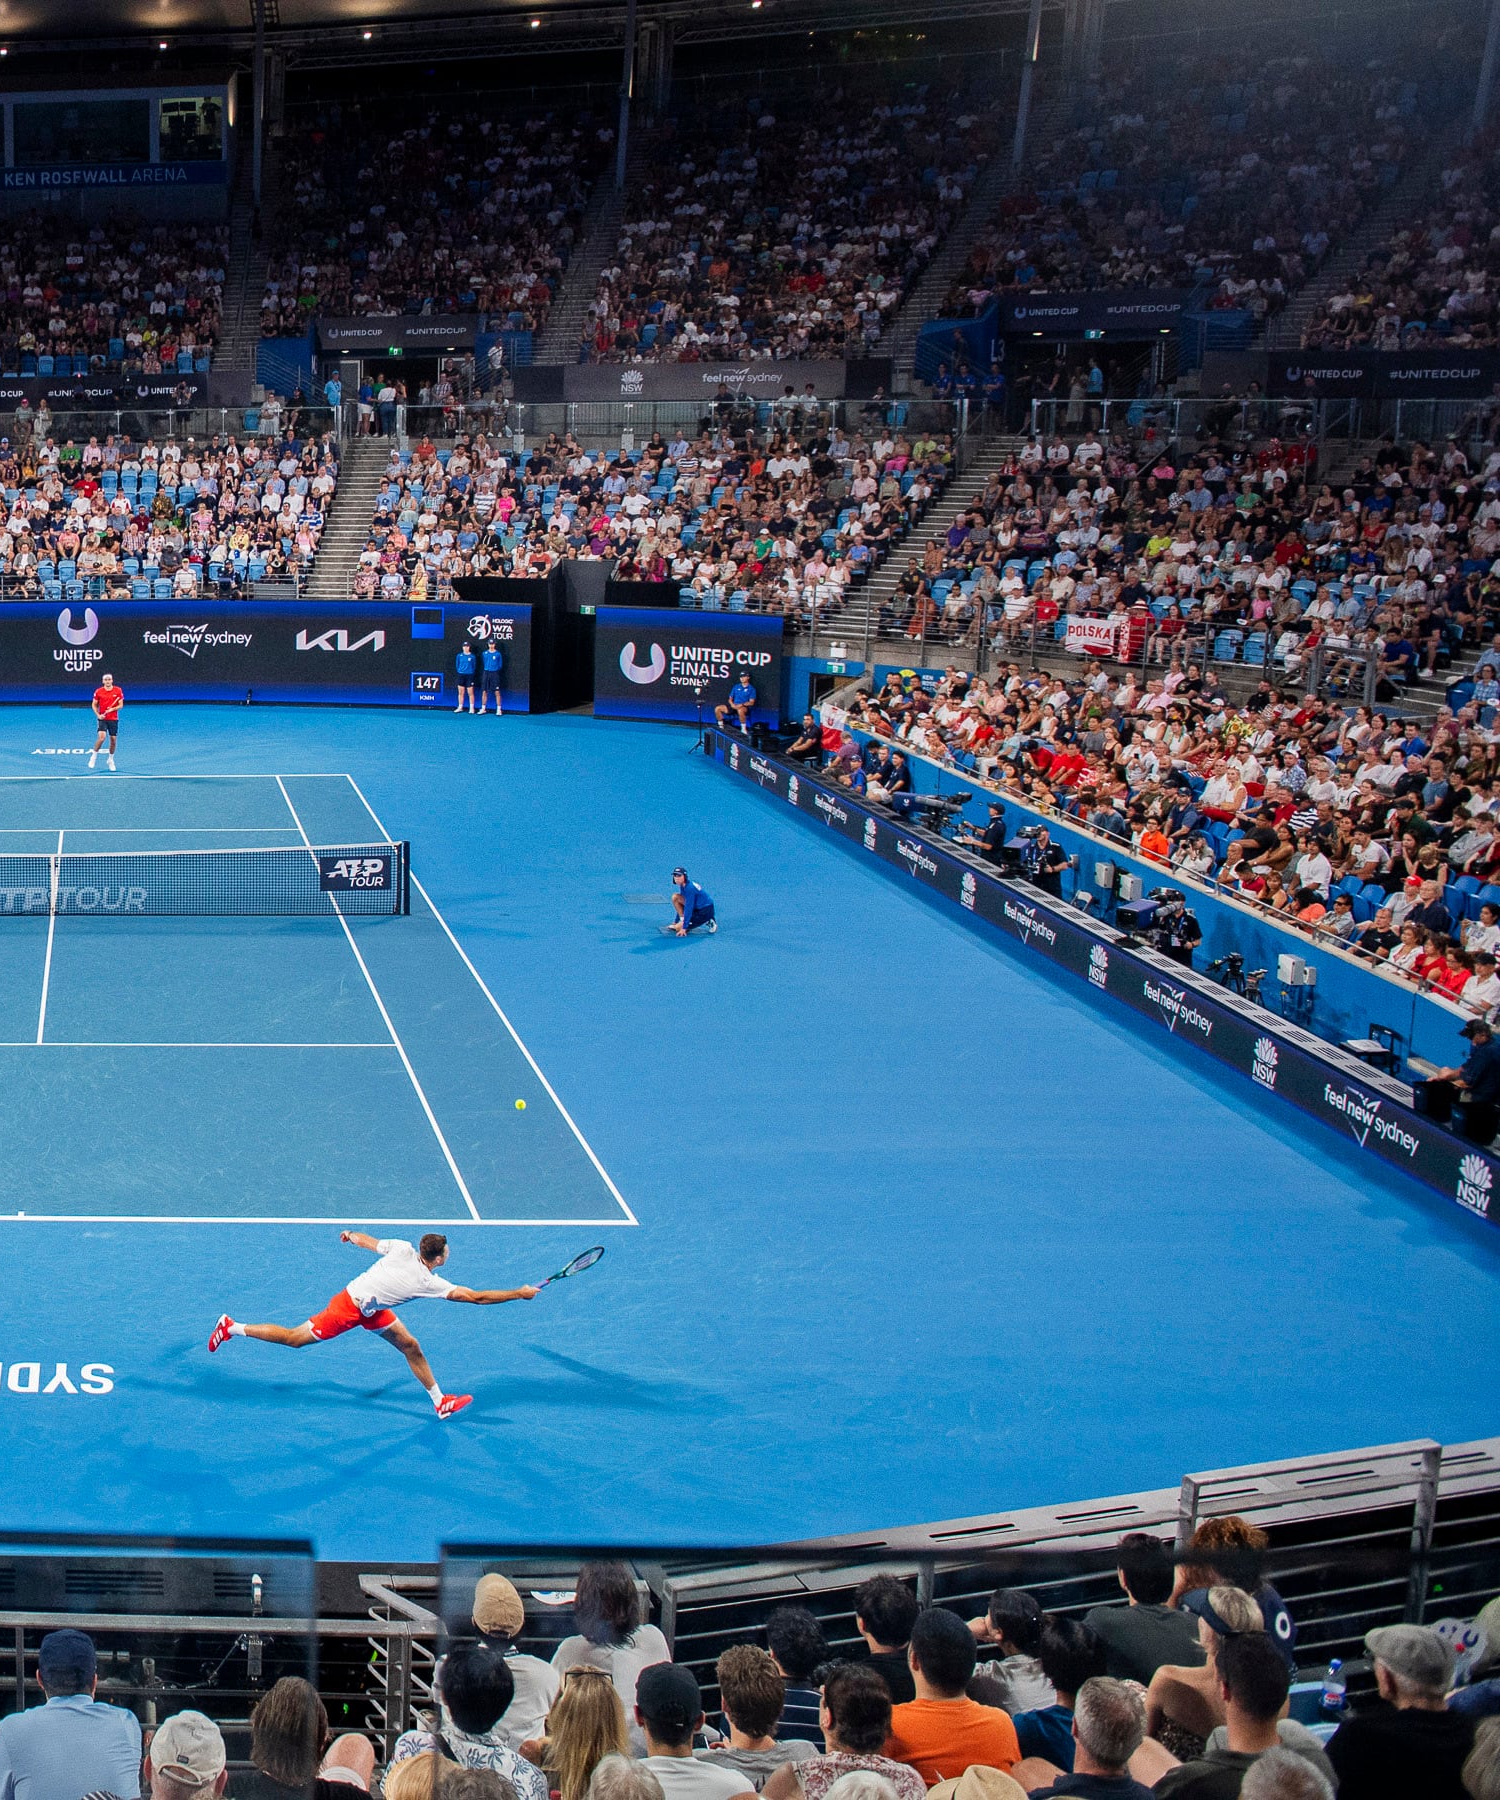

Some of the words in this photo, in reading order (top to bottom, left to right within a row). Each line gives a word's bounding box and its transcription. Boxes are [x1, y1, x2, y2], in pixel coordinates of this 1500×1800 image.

[4, 171, 36, 187] KEN
[131, 166, 188, 182] ARENA
[1029, 308, 1059, 317] UNITED
[1061, 307, 1079, 316] CUP
[340, 329, 367, 337] UNITED
[406, 327, 467, 335] #UNITEDCUP
[702, 373, 722, 383] feel
[723, 374, 745, 383] new
[747, 373, 783, 385] sydney
[1341, 369, 1363, 378] CUP
[1390, 368, 1481, 380] #UNITEDCUP
[7, 390, 24, 398] CUP
[621, 384, 643, 392] NSW
[1067, 625, 1111, 640] POLSKA
[143, 631, 169, 644] feel
[172, 633, 203, 644] new
[204, 631, 253, 648] sydney
[53, 649, 103, 661] UNITED
[670, 646, 734, 664] UNITED
[736, 651, 772, 667] CUP
[64, 661, 93, 672] CUP
[670, 661, 730, 679] FINALS
[416, 677, 439, 689] 147
[670, 676, 709, 687] SYDNEY
[325, 858, 384, 878] ATP
[349, 876, 384, 887] TOUR
[58, 886, 148, 911] TOUR
[1004, 900, 1018, 921] feel
[1017, 911, 1032, 928] new
[1031, 916, 1057, 946] sydney
[1088, 963, 1107, 985] NSW
[1143, 980, 1160, 1005] feel
[1160, 994, 1180, 1014] new
[1180, 1003, 1213, 1037] sydney
[1252, 1059, 1277, 1085] NSW
[1323, 1083, 1347, 1111] feel
[1347, 1099, 1374, 1127] new
[1374, 1115, 1420, 1157] sydney
[1456, 1179, 1491, 1212] NSW
